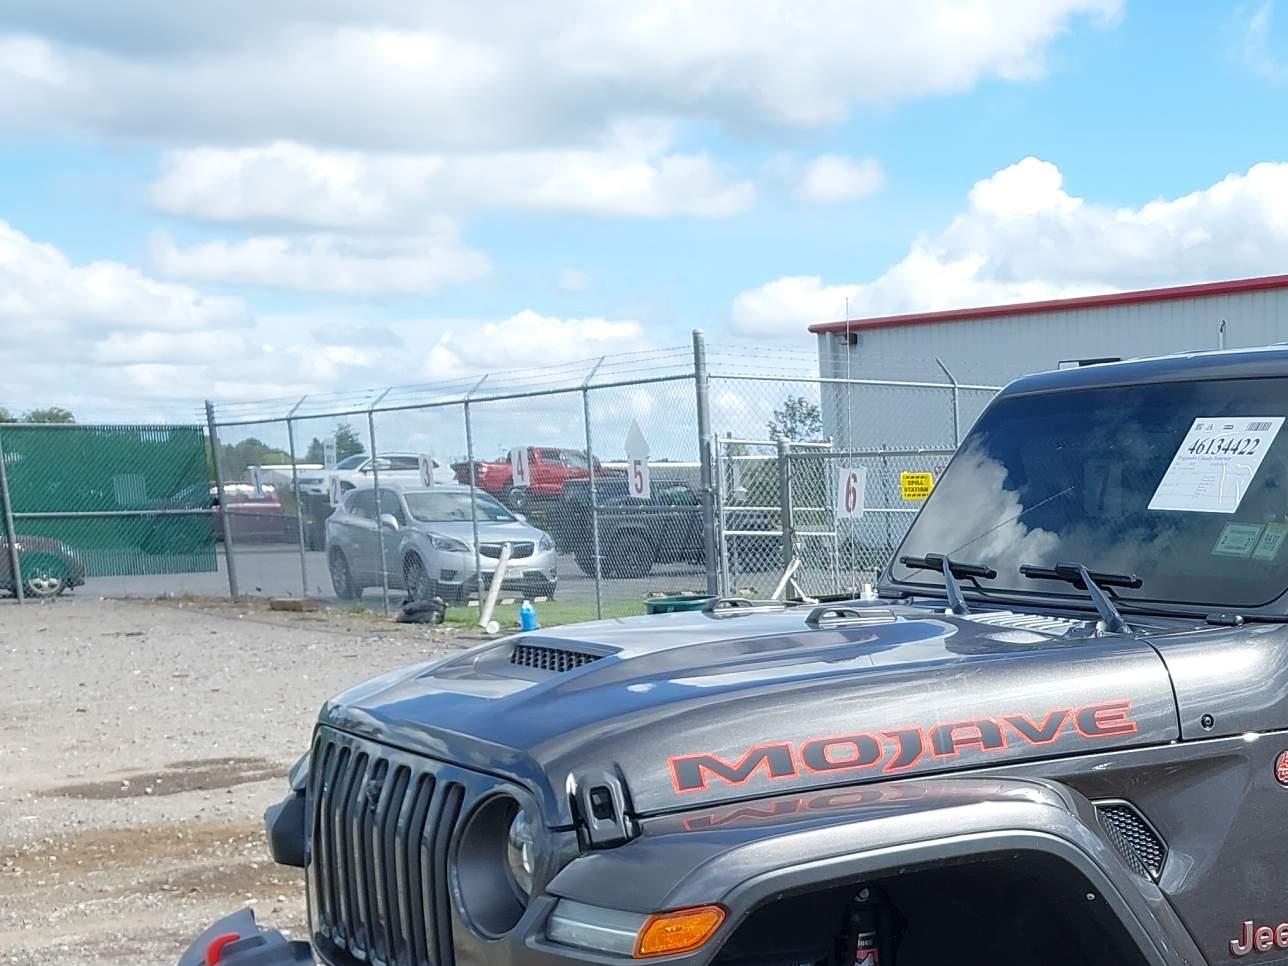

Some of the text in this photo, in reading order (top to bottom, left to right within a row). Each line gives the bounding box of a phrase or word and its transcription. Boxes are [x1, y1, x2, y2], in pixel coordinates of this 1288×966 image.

[1188, 437, 1261, 456] 46134422
[422, 456, 432, 488] 3
[515, 450, 526, 482] 4
[633, 459, 645, 494] 5
[845, 471, 859, 513] 6
[668, 699, 1137, 793] MOJAVE
